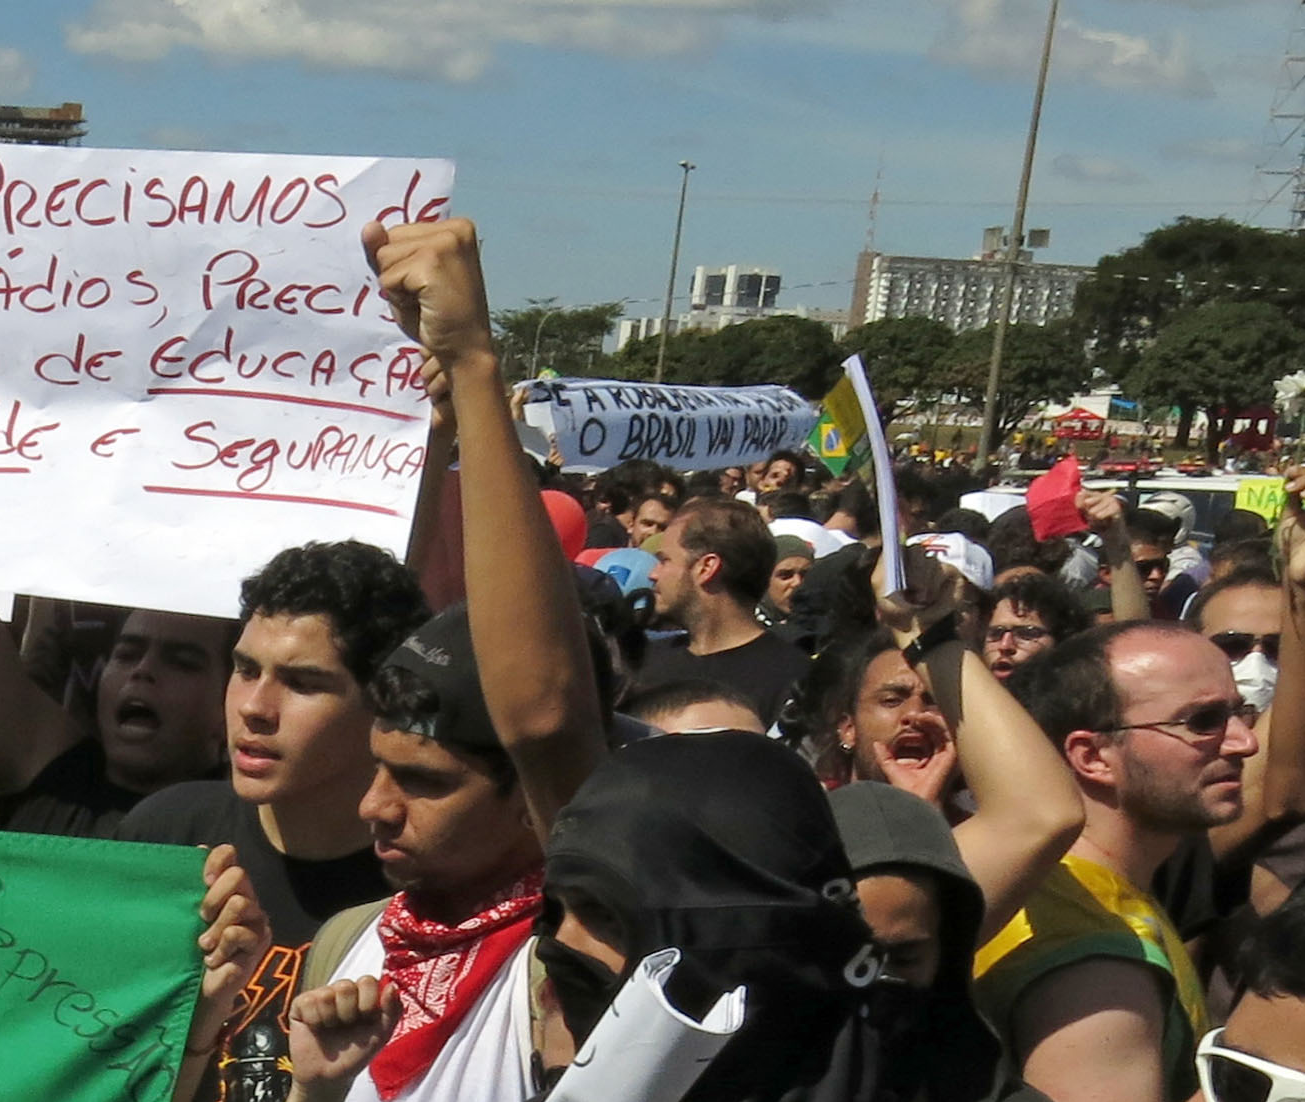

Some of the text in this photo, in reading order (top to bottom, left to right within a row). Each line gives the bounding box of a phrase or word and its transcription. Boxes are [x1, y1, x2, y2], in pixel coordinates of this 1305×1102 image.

[579, 417, 607, 456] O
[618, 413, 696, 460] BRASIL
[707, 414, 735, 456] VAI
